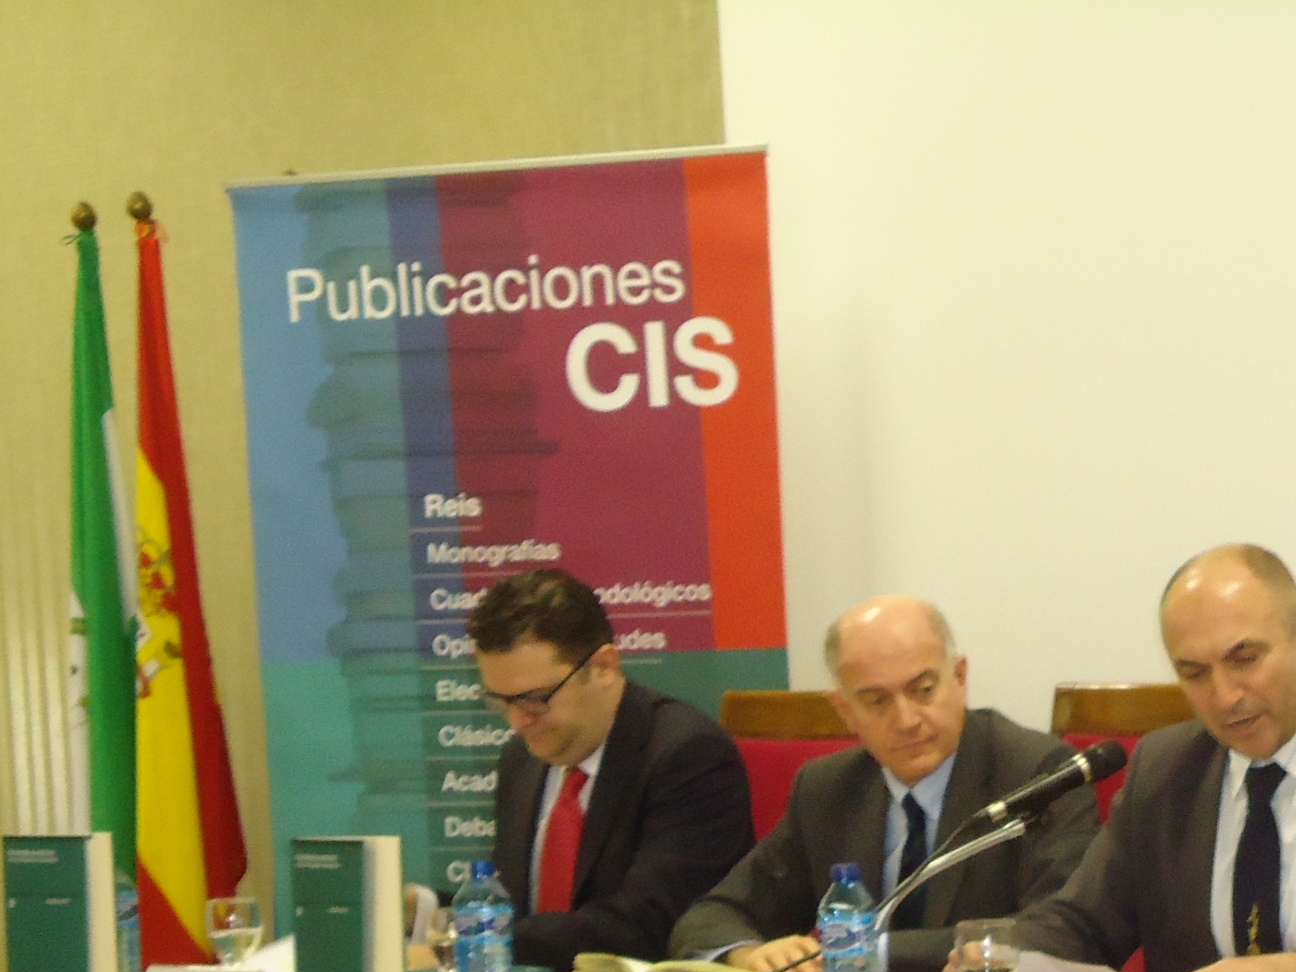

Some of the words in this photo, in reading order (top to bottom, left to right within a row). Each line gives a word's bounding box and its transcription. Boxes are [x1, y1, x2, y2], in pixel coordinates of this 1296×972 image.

[286, 254, 686, 323] Publicaciones
[565, 315, 740, 412] CIS
[424, 493, 482, 519] Reis
[427, 539, 562, 567] Monografías
[430, 587, 488, 611] Cuad
[594, 580, 713, 608] odológicos
[435, 680, 482, 701] Elec
[441, 770, 499, 792] Acad
[444, 816, 497, 837] Deba
